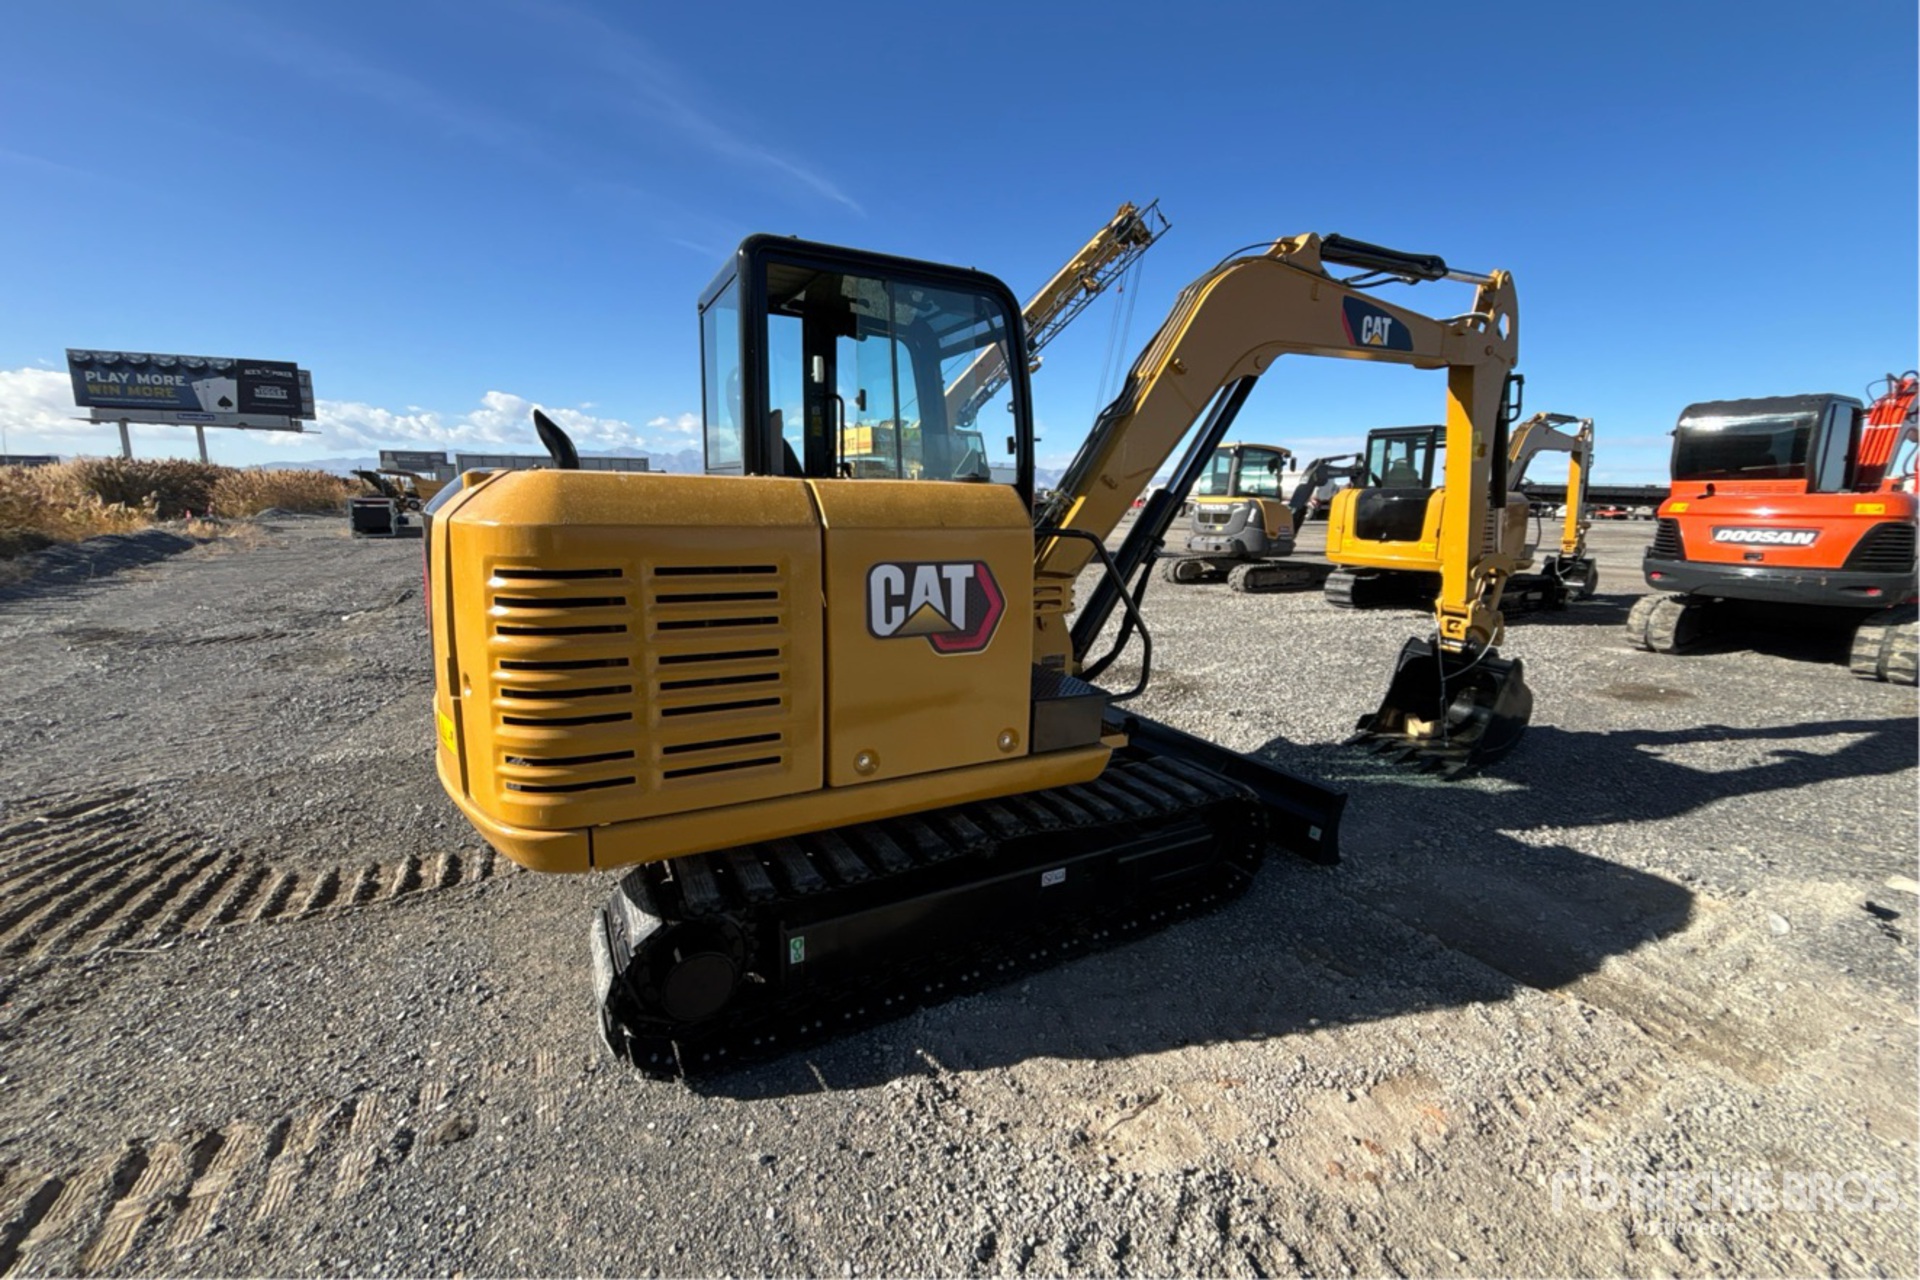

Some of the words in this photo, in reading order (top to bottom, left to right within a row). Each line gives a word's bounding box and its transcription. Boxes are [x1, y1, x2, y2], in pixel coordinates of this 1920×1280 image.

[1362, 315, 1392, 346] CAT
[84, 371, 130, 384] PLAY
[87, 384, 120, 395] WIN
[1201, 503, 1229, 511] VOLVO
[1715, 529, 1816, 544] DOOSAN
[870, 564, 974, 636] CAT
